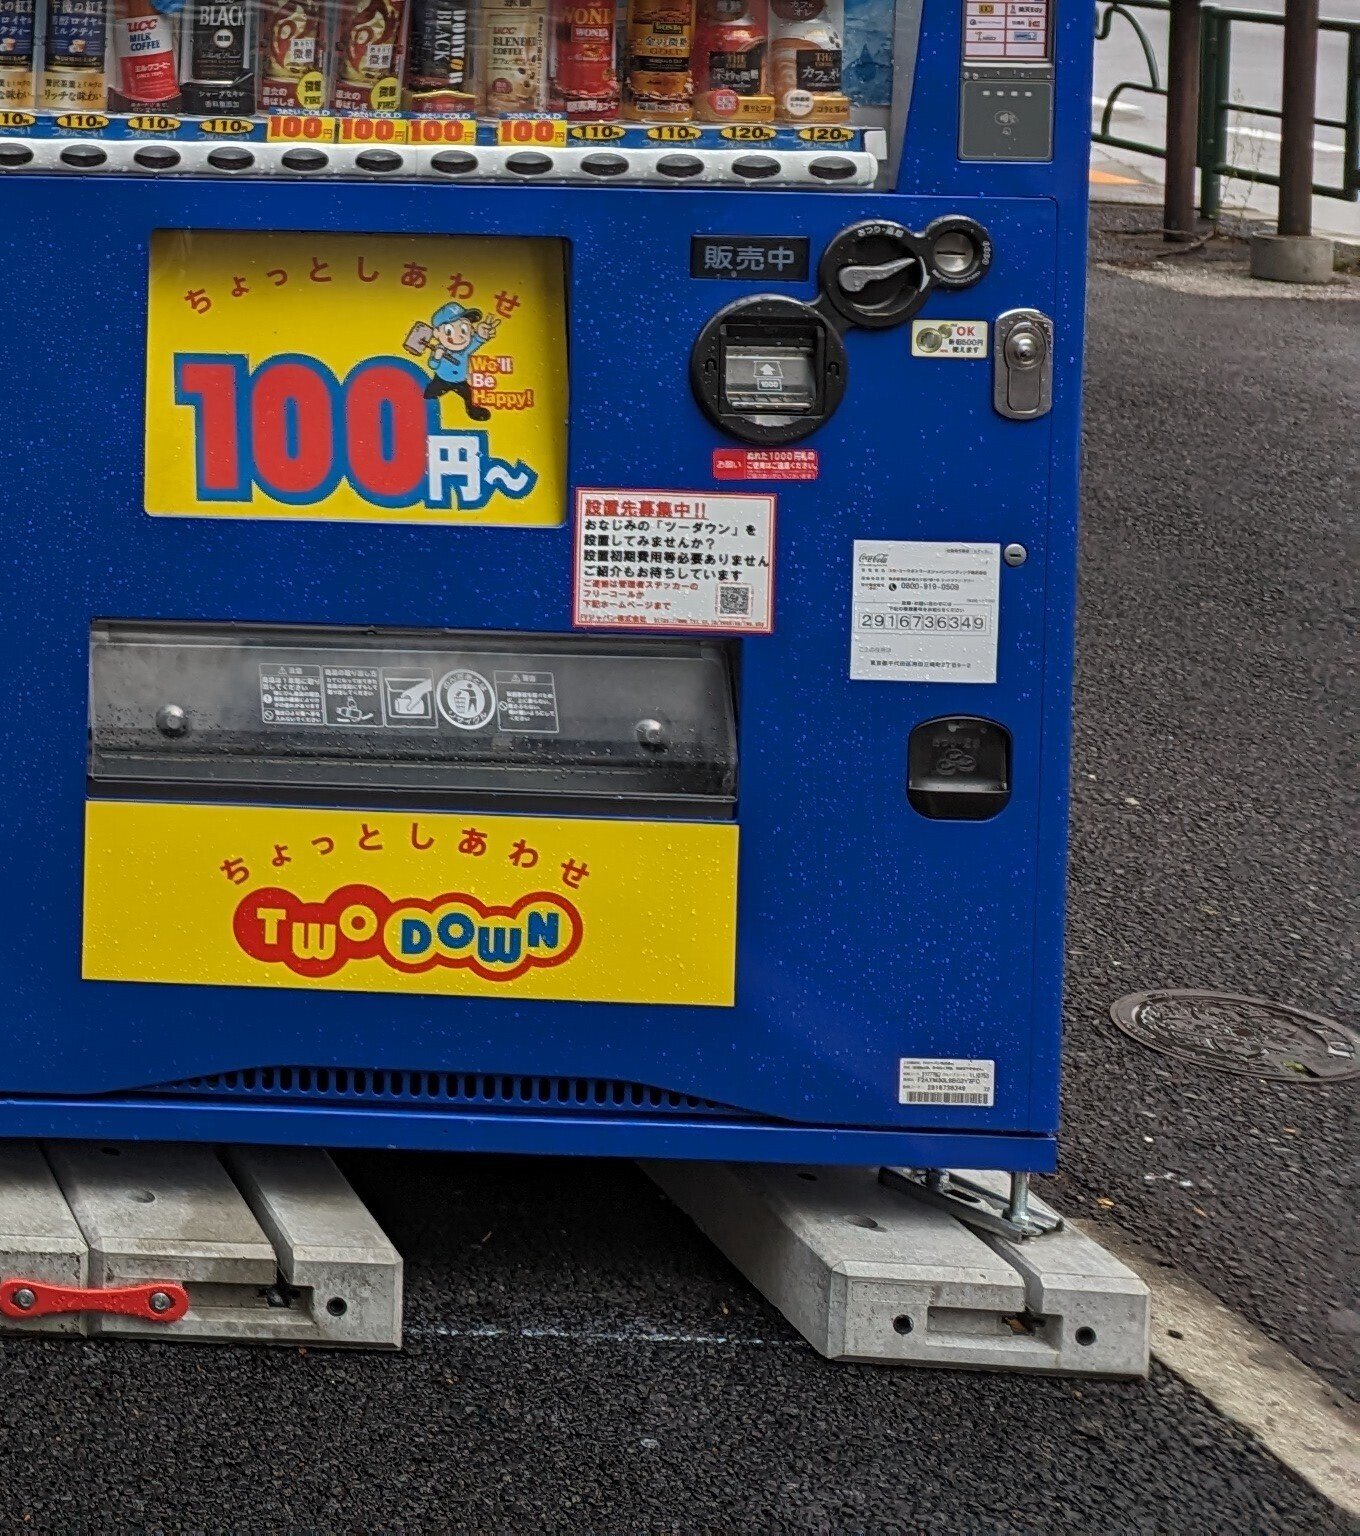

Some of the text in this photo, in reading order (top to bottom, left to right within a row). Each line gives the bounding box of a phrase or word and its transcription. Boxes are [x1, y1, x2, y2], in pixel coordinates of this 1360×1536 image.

[127, 19, 157, 33] UCC
[130, 33, 152, 43] MILK
[130, 41, 161, 52] COFFEE
[704, 246, 795, 271] 販売中
[184, 256, 521, 321] ちょっとしあわせ
[956, 326, 976, 337] OK
[471, 372, 497, 390] Be
[471, 388, 535, 411] Happy!
[584, 549, 770, 568] 設置初期費用等必要ありません
[584, 565, 743, 581] ご紹介もお待ちしています
[861, 614, 985, 630] 2916736349
[220, 822, 591, 890] ちょっとしあわせ
[255, 904, 560, 964] TWO DOWN
